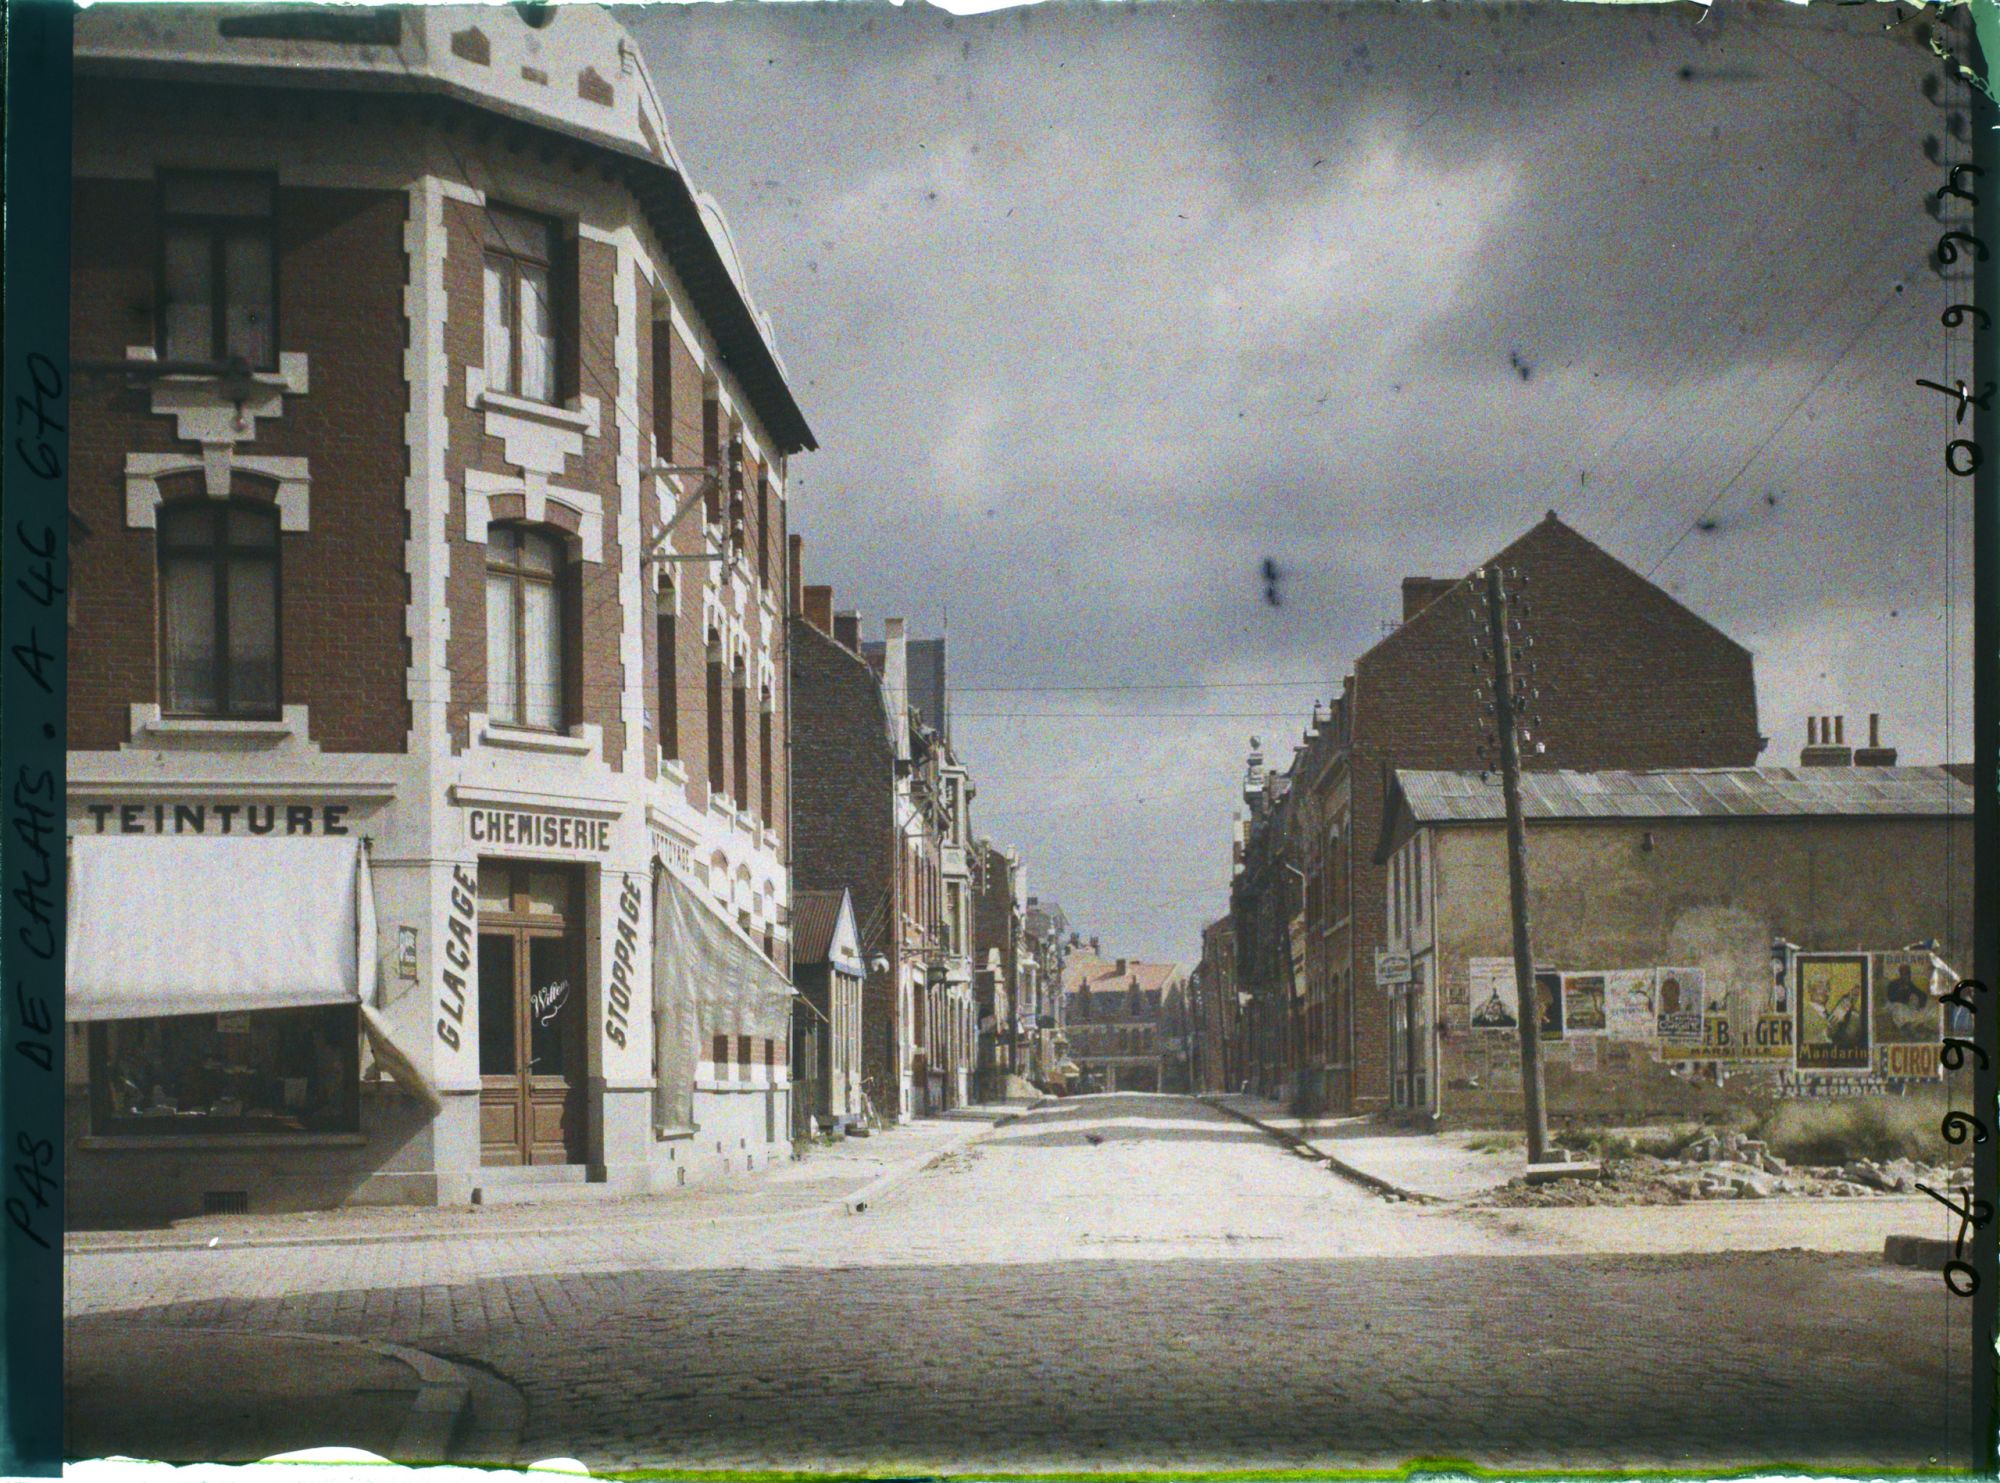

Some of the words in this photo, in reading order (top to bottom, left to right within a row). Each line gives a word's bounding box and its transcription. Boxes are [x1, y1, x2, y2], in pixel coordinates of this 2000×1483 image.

[18, 350, 60, 478] 670
[8, 633, 52, 695] A
[88, 804, 349, 836] TEINTURE
[469, 810, 610, 852] CHEMISERIE
[437, 865, 479, 1053] GLACAGE
[605, 872, 643, 1050] STOPPAGE
[16, 983, 55, 1068] DE
[6, 1130, 52, 1249] PAS
